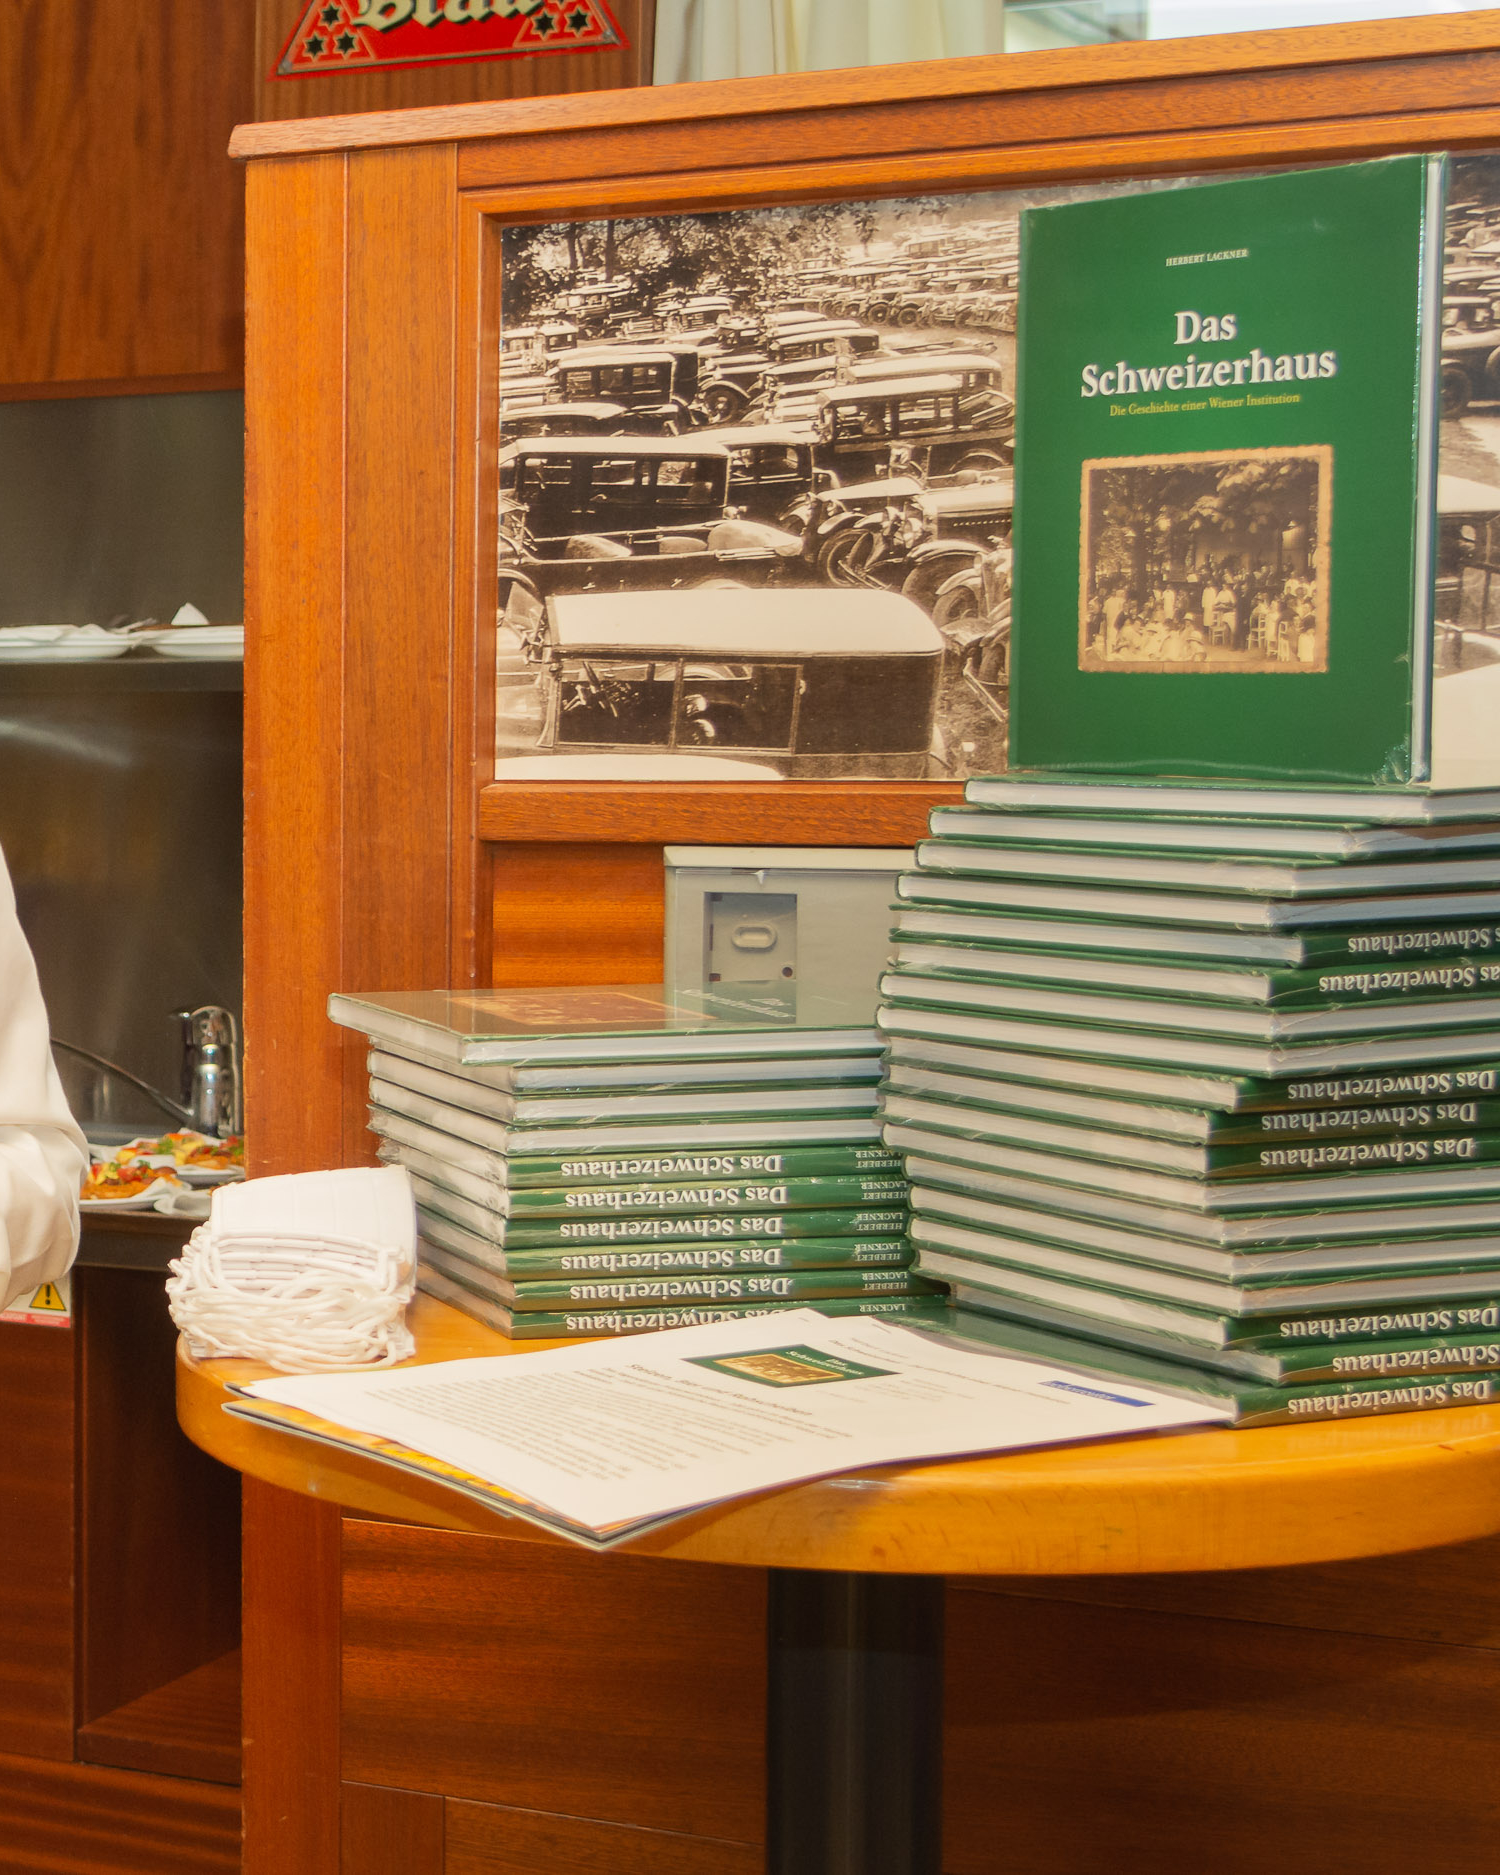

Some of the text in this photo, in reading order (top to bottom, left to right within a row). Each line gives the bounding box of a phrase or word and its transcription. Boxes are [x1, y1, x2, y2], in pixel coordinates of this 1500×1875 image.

[1165, 248, 1249, 267] HERBERT LACKNER
[1173, 310, 1237, 345] Das
[1080, 348, 1338, 398] Schweizerhaus
[1109, 393, 1300, 417] Die Geschichte einer Wiener Institution
[1348, 928, 1491, 955] Schweizerhaus
[1319, 966, 1476, 995] Schweizerhaus
[1287, 1070, 1496, 1101] Das Schweizerhaus
[1261, 1102, 1478, 1132] Das Schweizerhaus
[855, 1160, 901, 1169] HERBERT
[1260, 1138, 1475, 1168] Das Schweizerhaus
[561, 1154, 782, 1178] Das Schweizerhaus
[860, 1180, 907, 1190] LACKNER
[861, 1191, 907, 1200] HERBERT
[565, 1185, 787, 1209] Das Schweizerhaus
[856, 1212, 903, 1221] LACKNER
[857, 1223, 903, 1231] HERBERT
[560, 1217, 783, 1240] Das Schweizerhaus
[855, 1242, 901, 1252] LACKNER
[855, 1253, 901, 1262] HERBERT
[561, 1248, 782, 1271] Das Schweizerhaus
[862, 1271, 908, 1280] LACKNER
[862, 1282, 907, 1290] HERBERT
[570, 1277, 790, 1302] Das Schweizerhaus
[566, 1309, 781, 1331] as Schweizerhaus
[860, 1304, 906, 1313] LACKNER
[1280, 1307, 1499, 1339] Das Schweizerhaus
[1332, 1343, 1500, 1373] Schweizerhaus
[1287, 1380, 1491, 1414] Das Schweizerhaus
